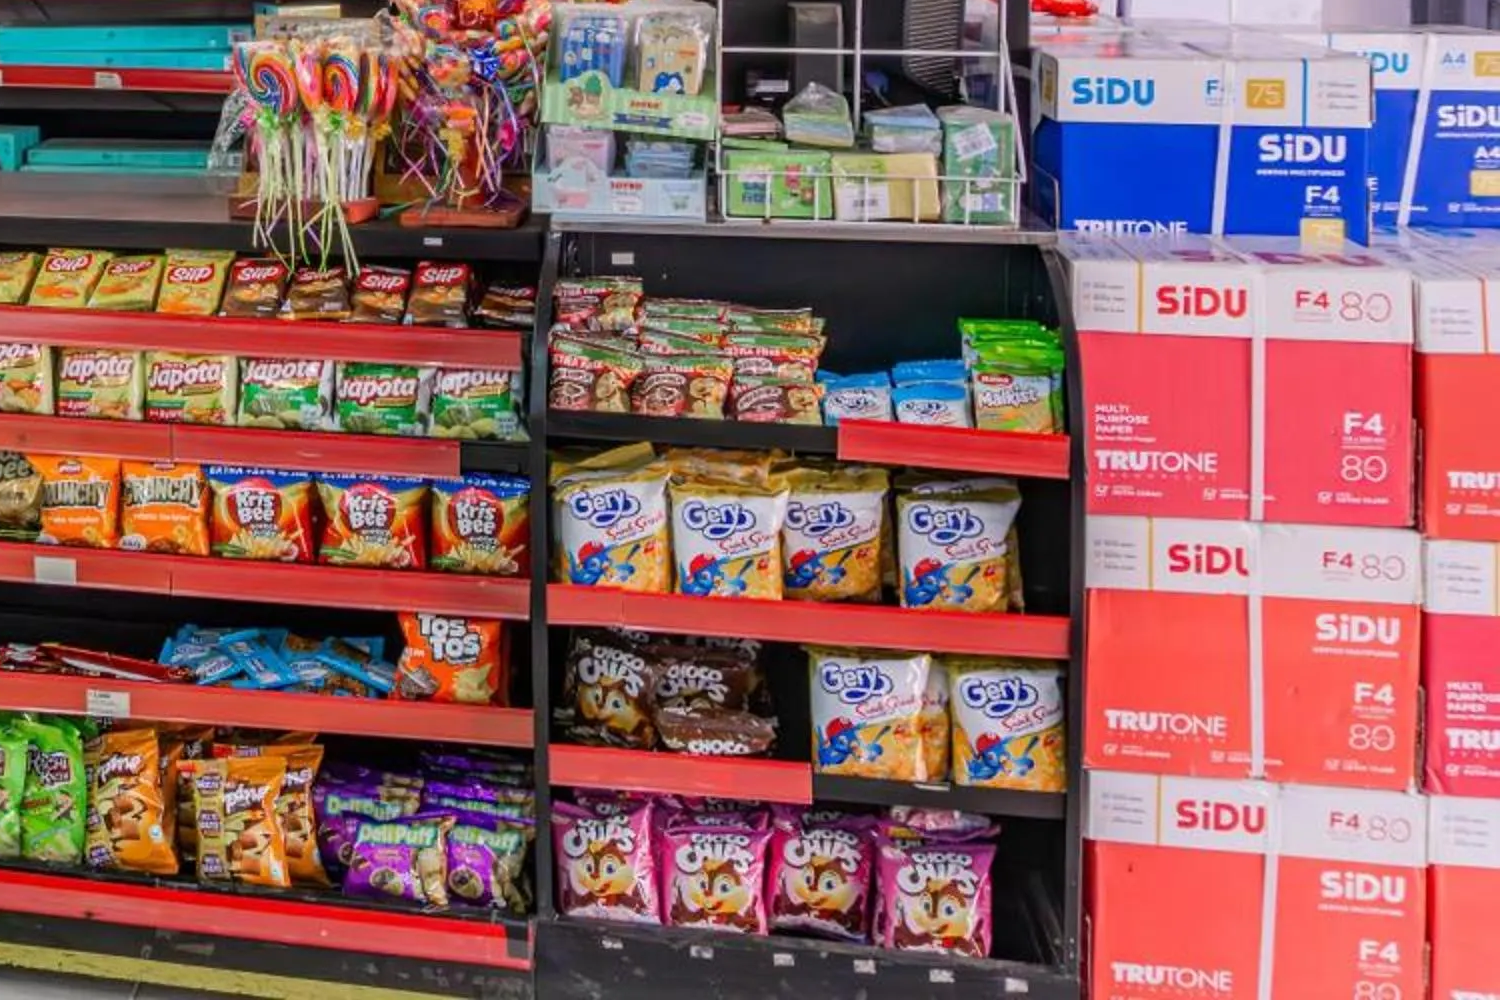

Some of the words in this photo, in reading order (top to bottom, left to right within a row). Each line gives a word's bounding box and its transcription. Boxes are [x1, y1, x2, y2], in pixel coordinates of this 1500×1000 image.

[1441, 53, 1467, 65] A4
[1072, 77, 1155, 106] SiDU
[1248, 83, 1283, 106] 75
[1258, 133, 1347, 163] SiDU
[1305, 185, 1340, 204] F4
[1156, 284, 1248, 318] SiDU
[1295, 289, 1330, 310] F4
[1095, 425, 1134, 435] PAPER
[1343, 411, 1384, 436] F4
[1095, 450, 1218, 474] TRUTONE
[1341, 454, 1388, 483] 80
[235, 490, 273, 510] Kris
[237, 505, 275, 522] Bee
[349, 494, 388, 514] Kris
[456, 501, 496, 521] Kris
[571, 488, 640, 528] Gery
[349, 510, 388, 528] Bee
[457, 517, 495, 535] Bee
[681, 500, 755, 540] Gery
[785, 499, 855, 536] Gery
[910, 505, 983, 544] Gery
[1322, 551, 1354, 569] F4
[417, 614, 469, 638] TOS
[1315, 613, 1401, 646] SiDU
[429, 634, 482, 661] TOS
[593, 646, 646, 669] CHOCO
[578, 658, 642, 698] CHIPS
[667, 664, 724, 682] CHOCO
[821, 661, 893, 704] Gery
[655, 674, 729, 703] CHIPS
[961, 676, 1039, 718] Gery
[1354, 682, 1396, 706] F4
[1105, 709, 1227, 737] TRUTONE
[1349, 723, 1396, 752] 80
[1175, 798, 1266, 835] SiDU
[1329, 810, 1360, 831] F4
[563, 820, 636, 858] CHIPS
[690, 832, 749, 849] CHOCO
[675, 839, 755, 873] CHIPS
[785, 837, 863, 873] CHIPS
[911, 851, 972, 868] CHOCO
[899, 859, 979, 896] CHIPS
[1319, 870, 1408, 904] SiDU
[1359, 939, 1401, 965] F4
[1111, 961, 1234, 990] TRUTONE
